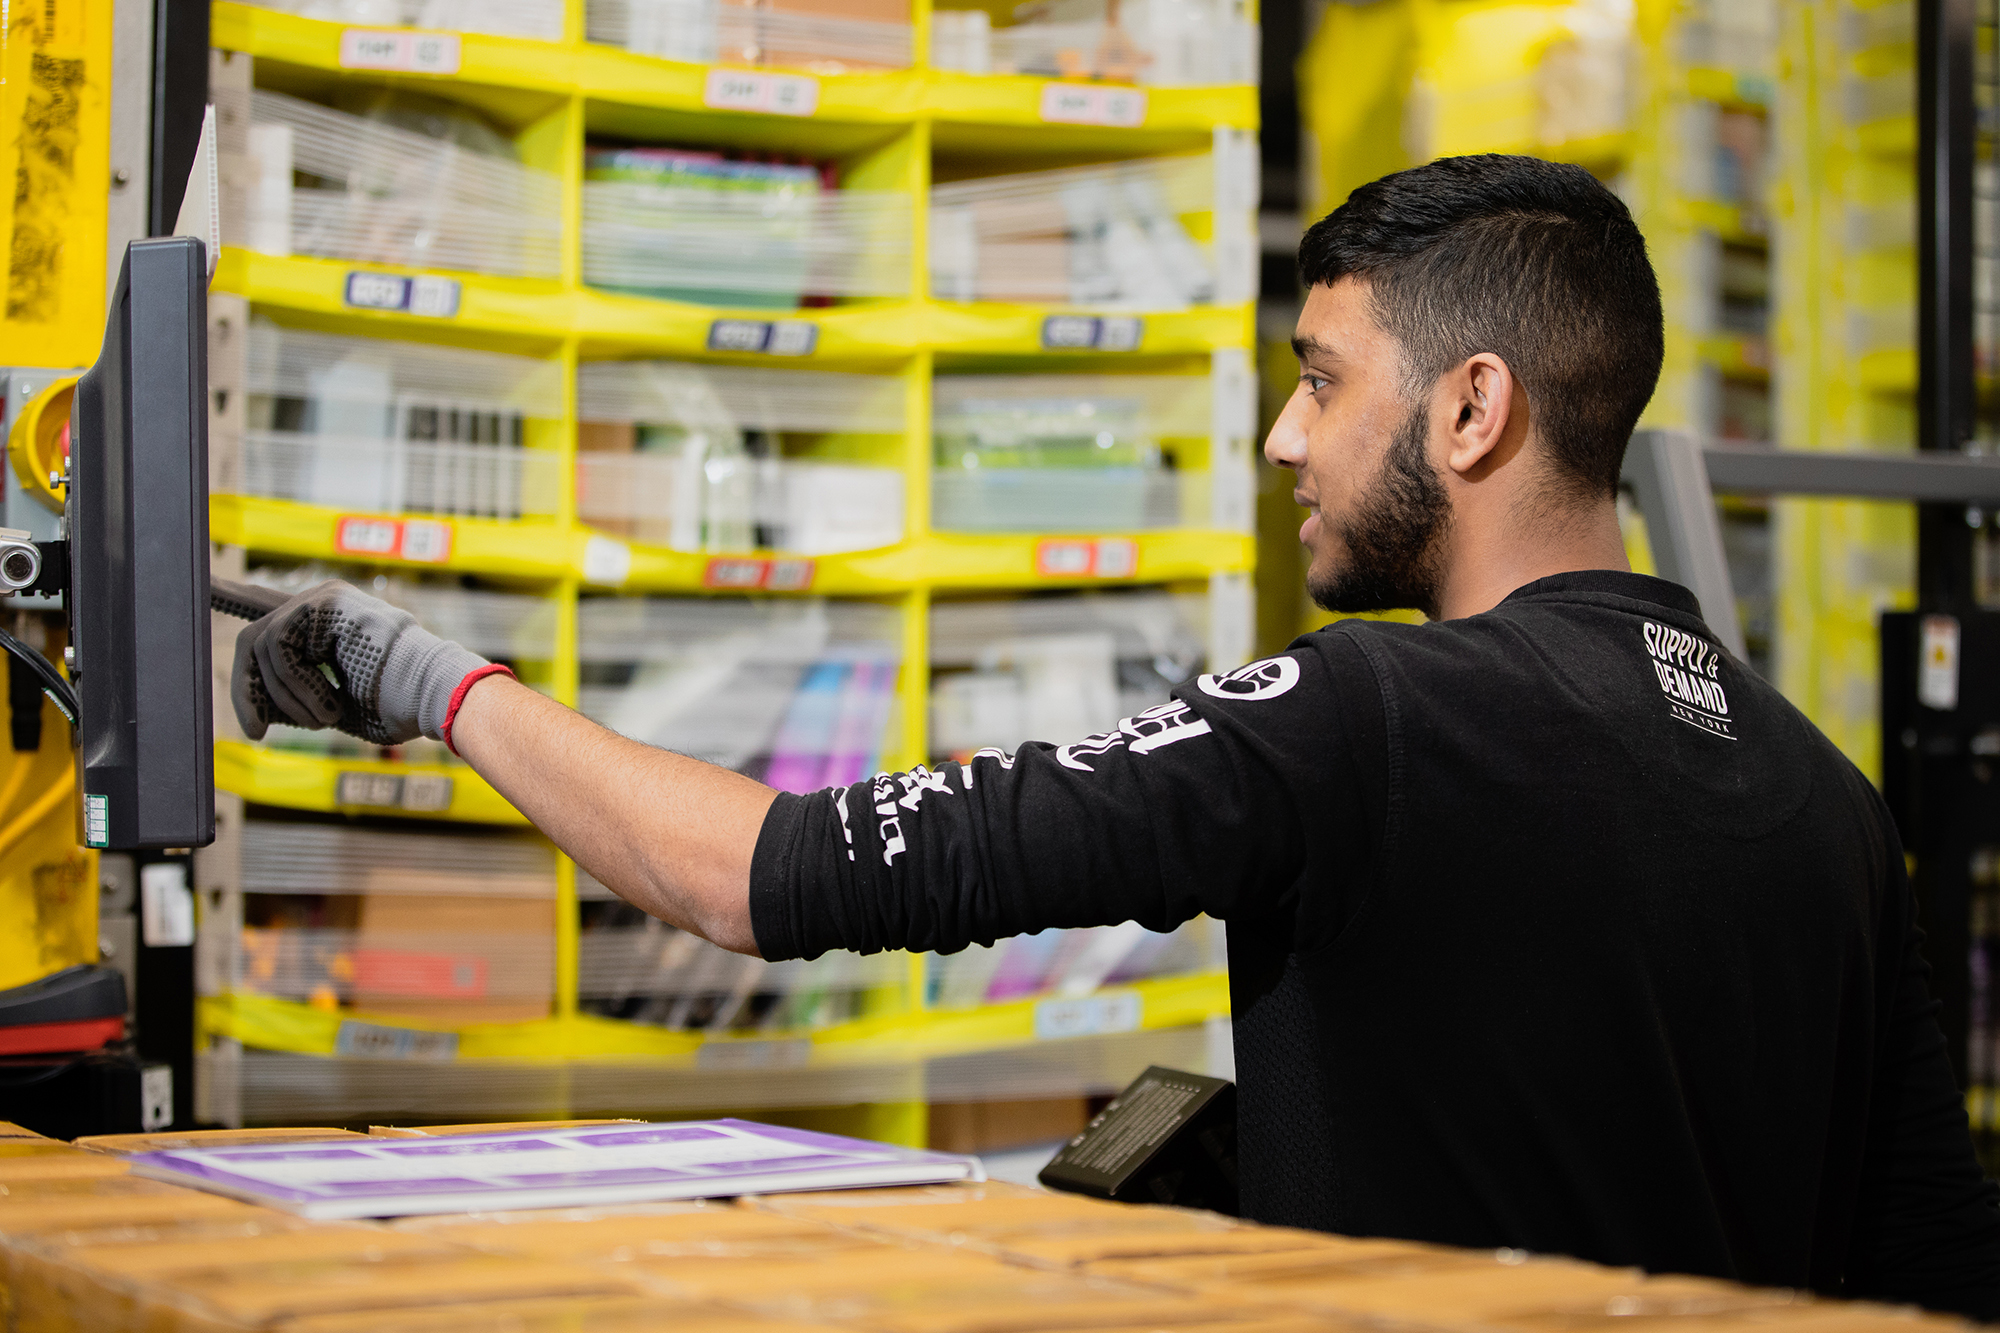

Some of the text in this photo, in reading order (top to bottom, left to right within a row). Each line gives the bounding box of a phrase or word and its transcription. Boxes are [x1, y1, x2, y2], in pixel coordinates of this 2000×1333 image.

[1643, 622, 1719, 680] SUPPLY &
[1652, 658, 1729, 715] DEMAND
[1671, 704, 1730, 733] NEW YORK
